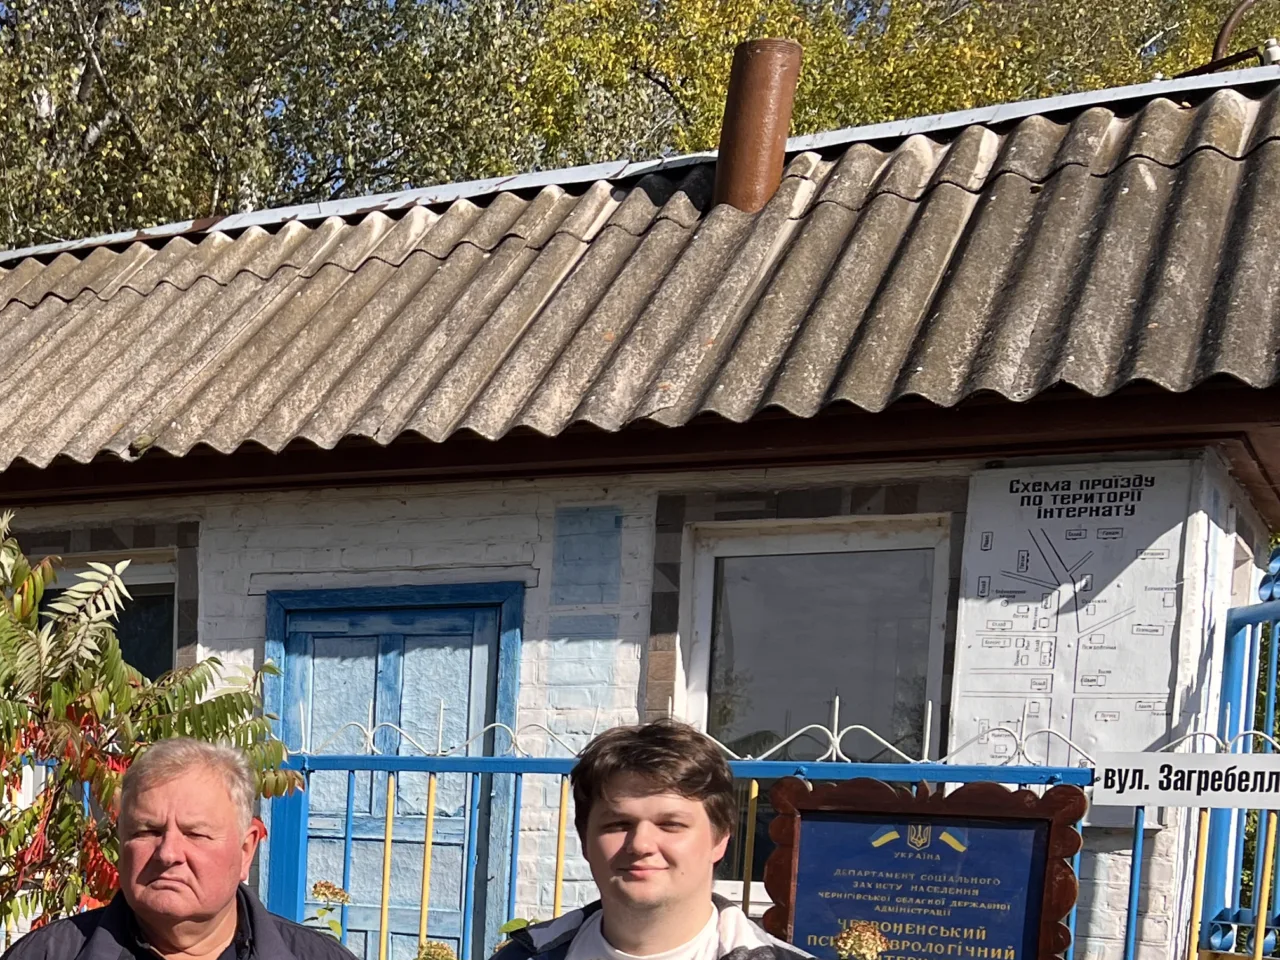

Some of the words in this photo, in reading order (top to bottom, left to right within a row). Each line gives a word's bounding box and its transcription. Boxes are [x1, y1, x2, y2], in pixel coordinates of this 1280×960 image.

[1009, 478, 1071, 494] Схема
[1079, 474, 1156, 491] проїзду
[1020, 494, 1043, 507] по
[1051, 489, 1144, 505] території
[1037, 504, 1136, 519] інтернату
[1103, 767, 1150, 794] вул.
[1158, 763, 1280, 797] Загребелл
[894, 851, 941, 861] УКРАЇНА
[833, 868, 916, 880] ДЕПАРТАМЕНТ
[920, 873, 1001, 886] СОЦІАЛЬНОГО
[852, 881, 903, 890] ЗАХИСТУ
[911, 884, 980, 896] НАСЕЛЕННЯ
[949, 899, 1011, 911] ДЕРЖАВНОЇ
[807, 934, 1016, 960] ПСВРОЛОГІЧНИЙ
